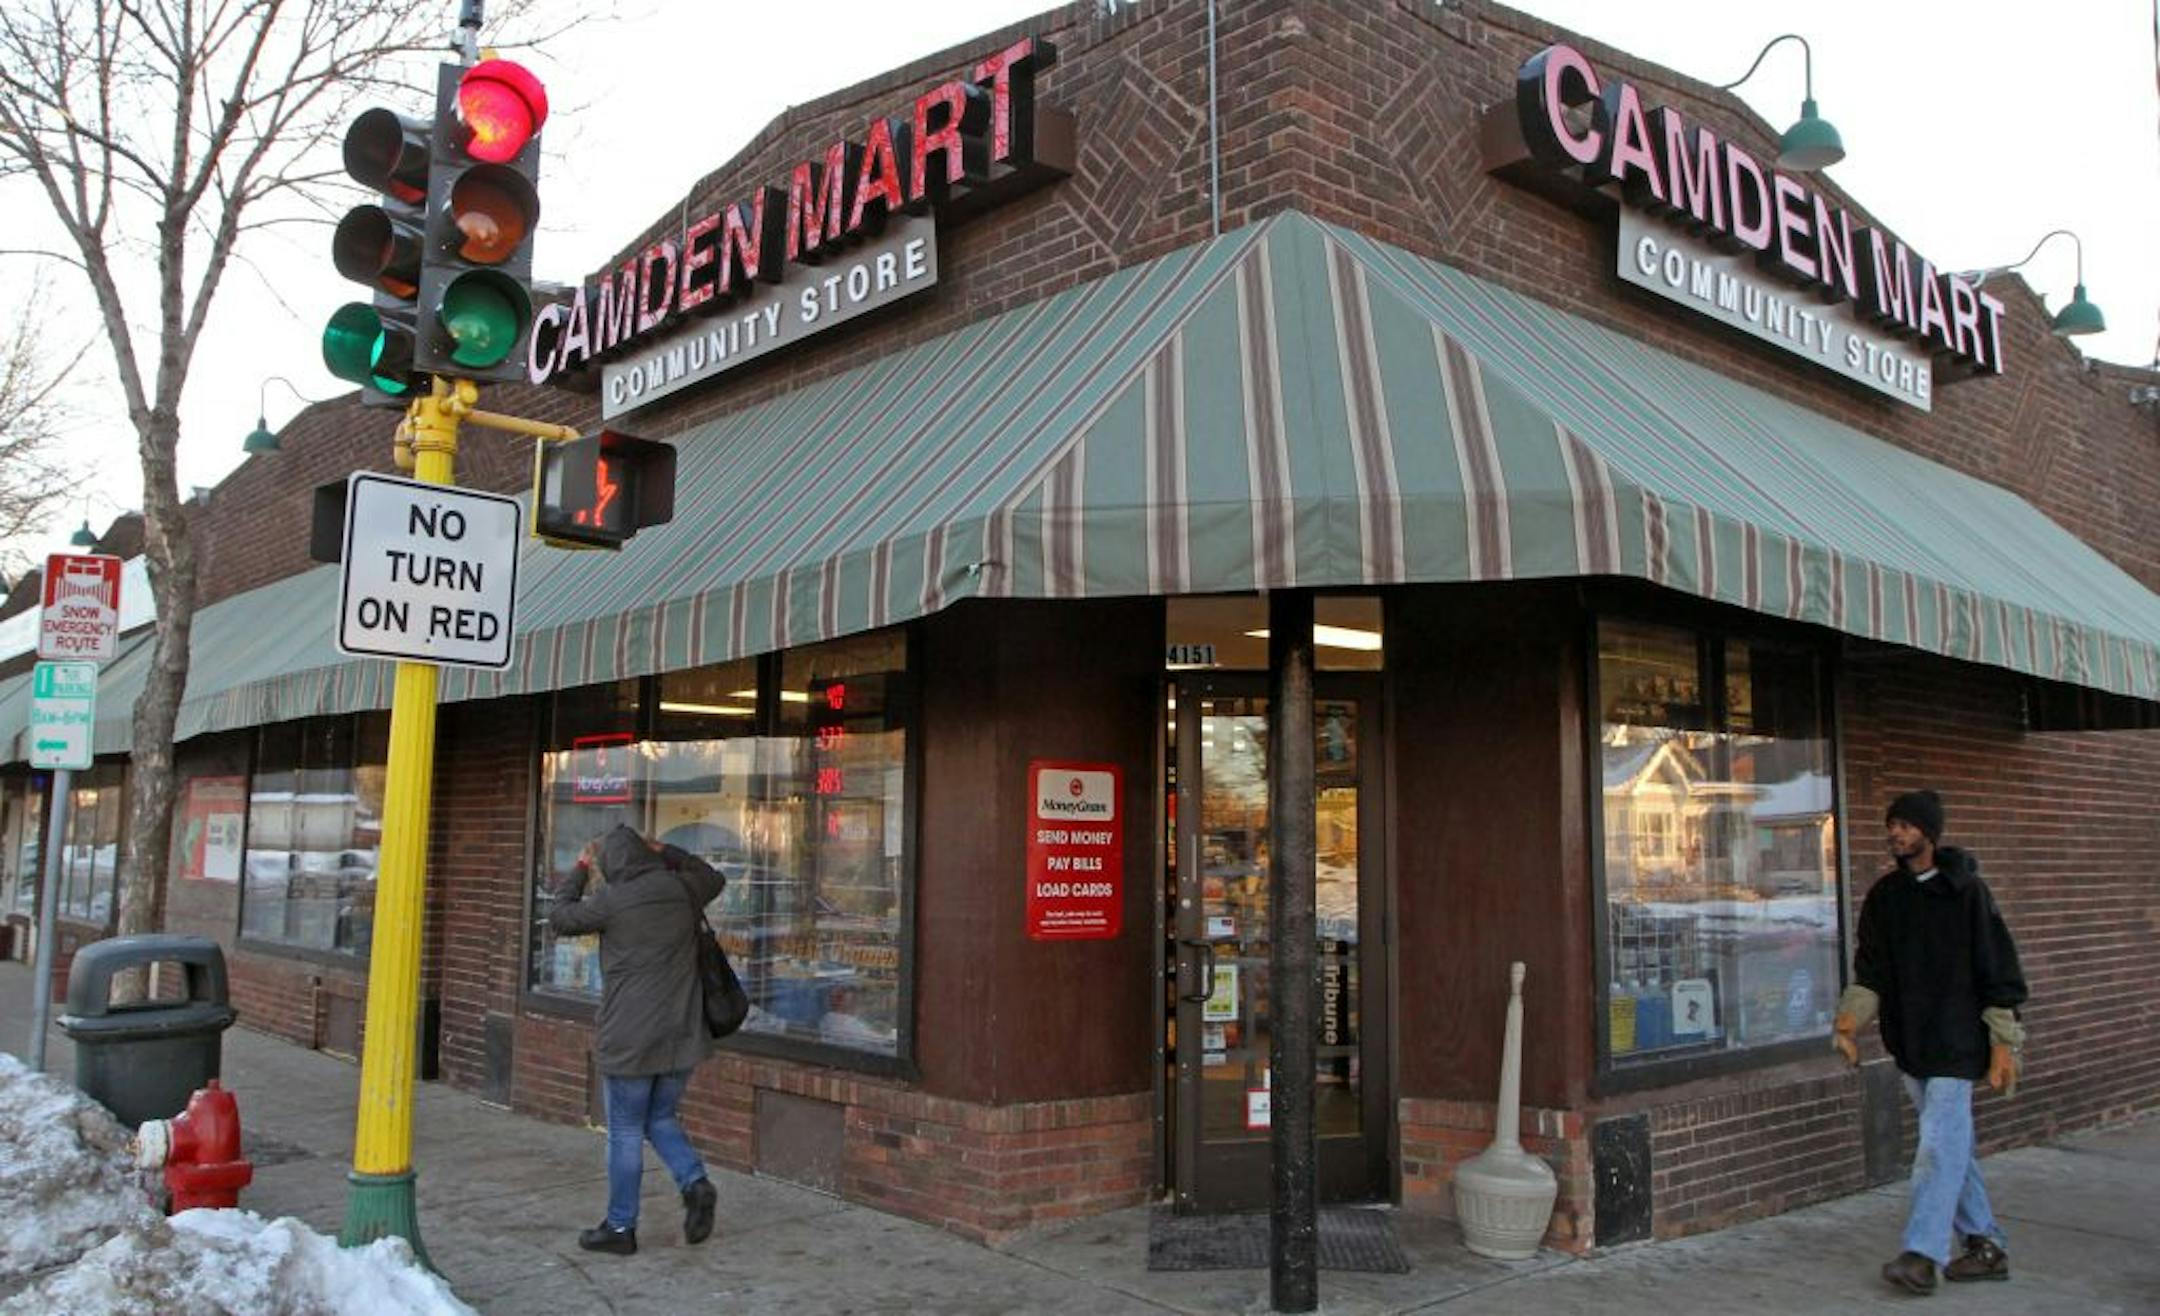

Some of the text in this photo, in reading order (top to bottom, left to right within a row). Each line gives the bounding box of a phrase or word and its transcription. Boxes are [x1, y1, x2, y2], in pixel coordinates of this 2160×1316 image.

[528, 36, 1036, 386] CAMDEN MART
[1543, 44, 2006, 376] CAMDEN MART
[610, 237, 929, 406] COMMUNITY STORE
[1636, 236, 1930, 399] COMMUNITY STORE
[409, 504, 466, 542] NO
[386, 550, 484, 592] TURN
[62, 604, 100, 619] SNOW
[358, 597, 499, 642] ON RED
[44, 619, 111, 636] EMERGENCY
[55, 636, 100, 650] ROUTE
[1168, 645, 1212, 664] 4151
[1041, 799, 1107, 815] MoneyGram
[1037, 830, 1113, 846] SEND MONEY
[1047, 857, 1103, 871] PAY BILLS
[1037, 883, 1113, 898] LOAD CARDS
